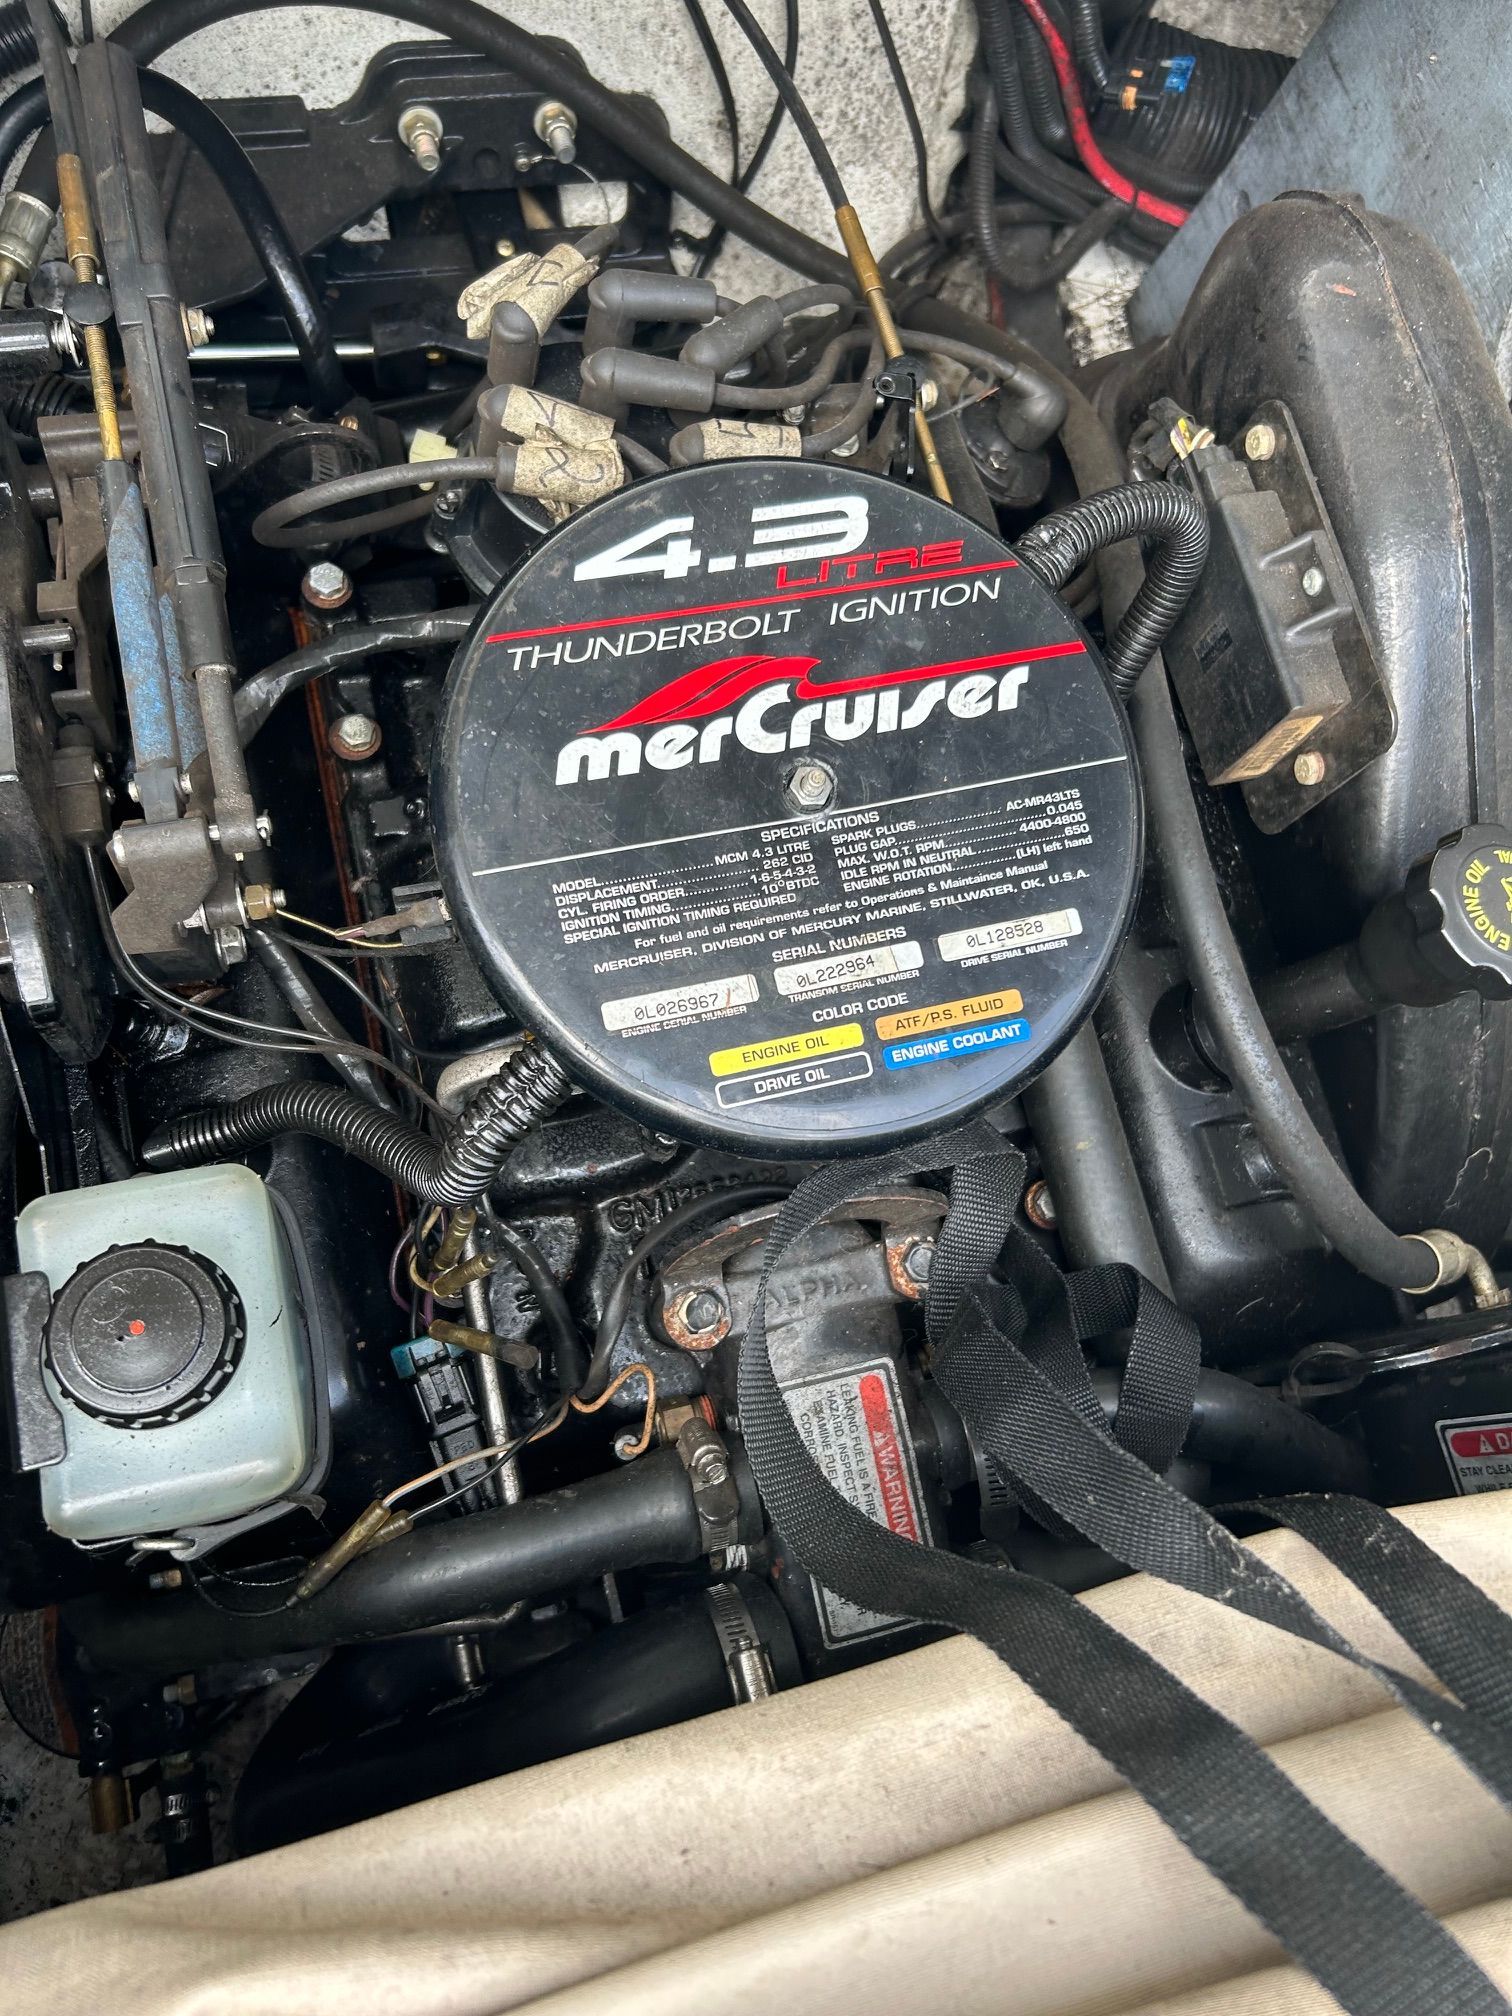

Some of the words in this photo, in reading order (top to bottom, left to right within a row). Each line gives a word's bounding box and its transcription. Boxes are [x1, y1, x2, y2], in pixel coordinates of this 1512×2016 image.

[573, 495, 868, 581] 4.3
[775, 540, 963, 589] LITRE
[507, 608, 801, 670] THUNDERBOLT
[829, 577, 1000, 625] IGNITION
[760, 810, 879, 842] SPECIFICATIONS
[830, 828, 873, 844] SPARK
[875, 820, 916, 836] PLUGS
[1006, 788, 1080, 811] AC-MR43LTS
[833, 842, 867, 856] PLUG
[869, 836, 896, 849] GAP
[1046, 799, 1082, 815] 0.045
[714, 850, 748, 865] MCM
[751, 846, 773, 858] 4.3
[776, 840, 810, 854] LITRE
[837, 854, 870, 868] MAX.
[872, 845, 912, 861] W.O.T.
[915, 838, 945, 853] RPM
[1019, 811, 1086, 832] 4400-4800
[840, 866, 868, 880] IDLE
[870, 860, 900, 874] RPM
[902, 857, 917, 868] IN
[919, 846, 976, 865] NEUTRAL
[1064, 823, 1089, 835] 650
[554, 878, 659, 906] DISPLACEMENT
[762, 856, 788, 869] 262
[791, 852, 813, 864] CID
[842, 874, 890, 892] ENGINE
[892, 862, 952, 882] ROTATION
[1015, 844, 1040, 859] (LH)
[1042, 841, 1062, 852] left
[1064, 834, 1092, 848] hand
[1465, 858, 1491, 884] OIL
[557, 905, 588, 918] CYL.
[591, 895, 636, 912] FIRING
[639, 887, 685, 903] ORDER
[749, 863, 816, 883] 1-6-5-4-3-2
[634, 937, 656, 949] For
[659, 930, 682, 943] fuel
[686, 925, 709, 938] and
[712, 922, 726, 934] oil
[729, 909, 809, 930] requirements
[812, 902, 842, 915] refer
[844, 900, 858, 908] to
[860, 886, 924, 905] Operations
[927, 882, 937, 892] &
[939, 871, 1003, 889] Maintaince
[1005, 859, 1048, 876] Manual
[560, 911, 620, 931] IGNITION
[622, 902, 671, 919] TIMING
[563, 925, 620, 944] SPECIAL
[622, 913, 680, 933] IGNITION
[682, 904, 730, 921] TIMING
[732, 892, 796, 912] REQUIRED
[701, 932, 764, 953] DIVISION
[768, 928, 787, 939] OF
[790, 913, 861, 935] MERCURY
[865, 901, 926, 921] MARINE,
[929, 883, 1017, 908] STILLWATER,
[1020, 877, 1045, 889] OK,
[1048, 869, 1090, 883] U.S.A.
[1463, 885, 1511, 951] ENGINE
[771, 942, 826, 962] SERIAL
[828, 926, 906, 951] NUMBERS
[960, 954, 989, 967] DRIVE
[990, 948, 1025, 961] SERIAL
[1023, 938, 1068, 954] NUMBER
[786, 984, 838, 1002] TRANSOM
[874, 969, 919, 985] NUMBER
[619, 1022, 661, 1038] ENGINE
[701, 1005, 747, 1021] NUMBER
[811, 1001, 863, 1022] COLOR
[866, 992, 909, 1010] CODE
[961, 998, 1003, 1016] FLUID
[741, 1041, 800, 1062] ENGINE
[805, 1035, 829, 1049] OIL
[891, 1039, 949, 1062] ENGINE
[952, 1023, 1020, 1048] COOLANT
[753, 1072, 801, 1093] DRIVE
[804, 1067, 830, 1082] OIL
[840, 1383, 859, 1434] LEAKING
[813, 1401, 832, 1452] EXAMINE
[825, 1454, 838, 1481] FUEL
[852, 1437, 865, 1466] FUEL
[837, 1443, 857, 1492] INSPECT
[858, 1465, 869, 1479] IS
[1459, 1466, 1484, 1477] STAY
[1485, 1464, 1512, 1476] CLEA
[862, 1483, 871, 1492] A
[864, 1491, 878, 1518] FIRE
